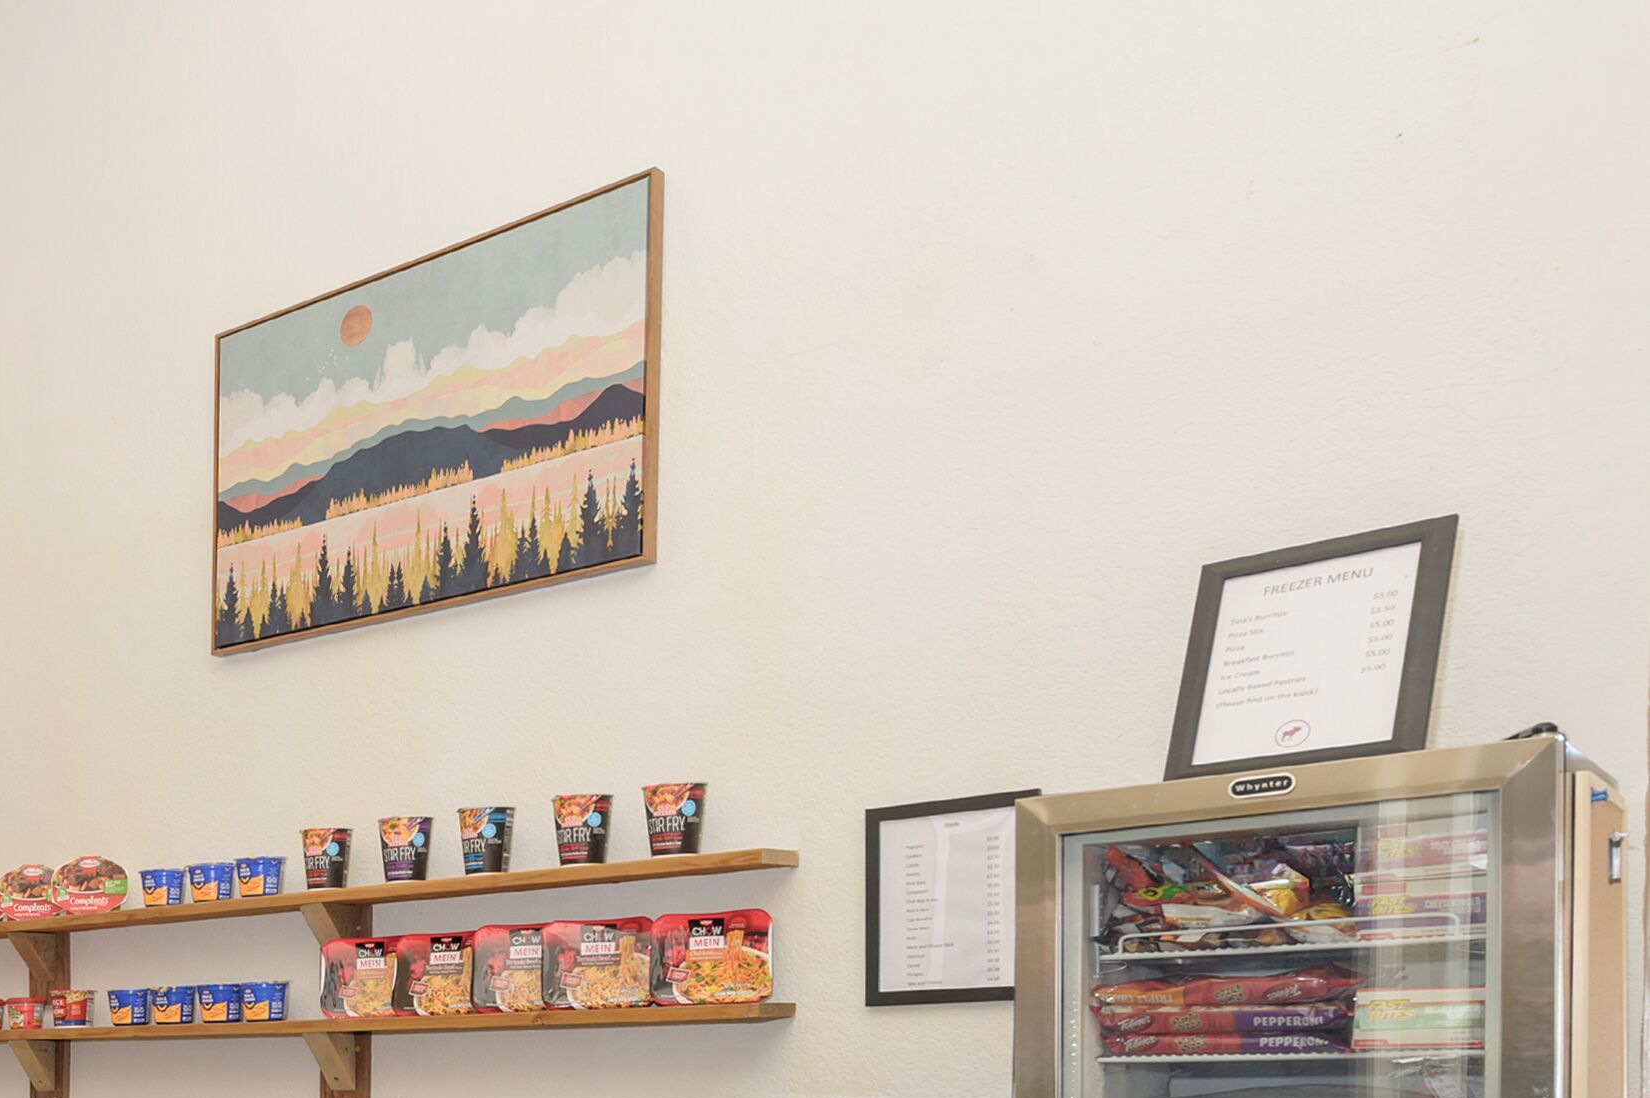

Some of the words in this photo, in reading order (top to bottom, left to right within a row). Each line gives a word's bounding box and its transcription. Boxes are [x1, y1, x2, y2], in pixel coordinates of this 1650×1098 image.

[1263, 577, 1323, 596] FREEZER
[1327, 567, 1374, 585] MENU
[1235, 778, 1289, 793] Whynter
[666, 816, 686, 832] FRY
[574, 827, 592, 842] FRY
[471, 838, 486, 852] FRY
[400, 846, 416, 860] FRY
[315, 856, 330, 869] FRY
[70, 897, 109, 906] Compleats
[14, 904, 51, 912] Compleats
[585, 944, 611, 953] MEIN
[694, 939, 720, 947] MEIN
[514, 948, 539, 956] MEIN
[434, 954, 457, 962] MEIN
[360, 960, 382, 968] MEIN
[1253, 1016, 1324, 1027] PEPPERONI
[1260, 1037, 1329, 1048] PEPPERON
